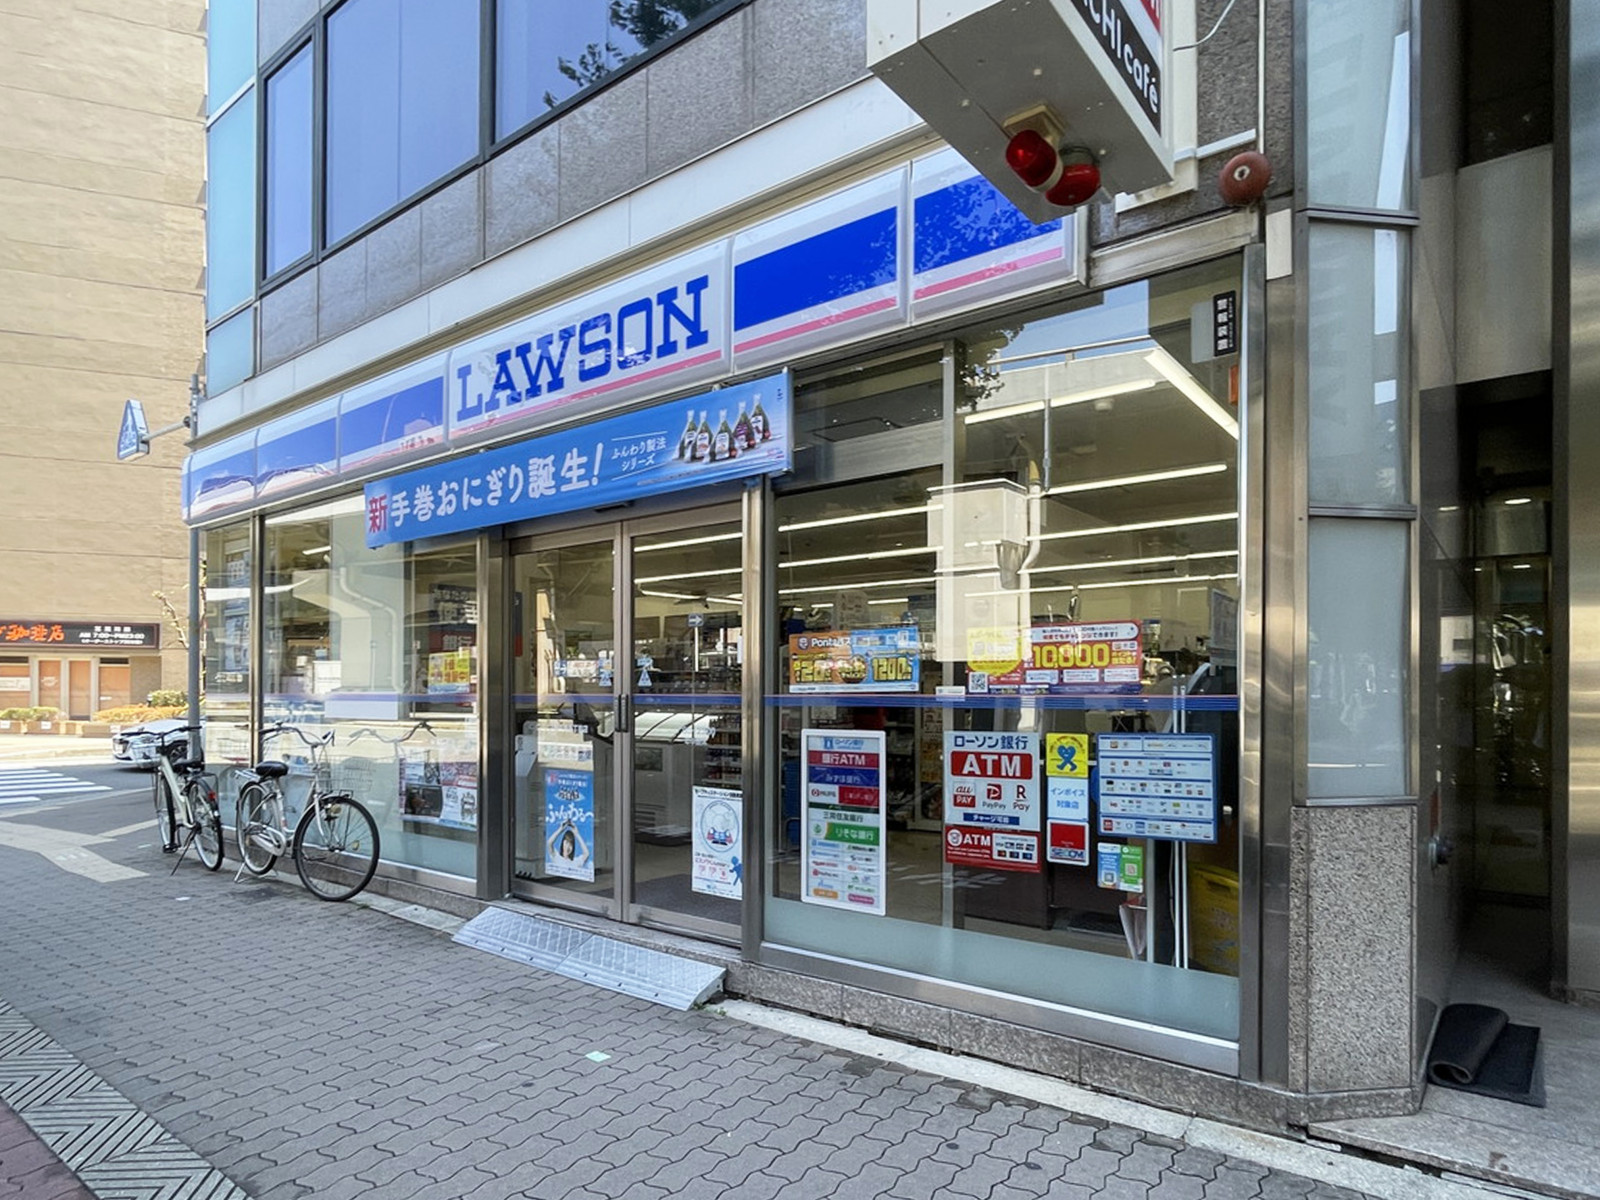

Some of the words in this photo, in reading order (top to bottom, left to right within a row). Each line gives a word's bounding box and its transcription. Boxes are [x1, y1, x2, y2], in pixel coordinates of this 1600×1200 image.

[457, 275, 709, 422] LAWSON
[621, 453, 656, 472] シリーズ
[954, 735, 1029, 750] ローソン銀行
[962, 753, 1022, 777] ATM
[963, 834, 991, 847] ATM
